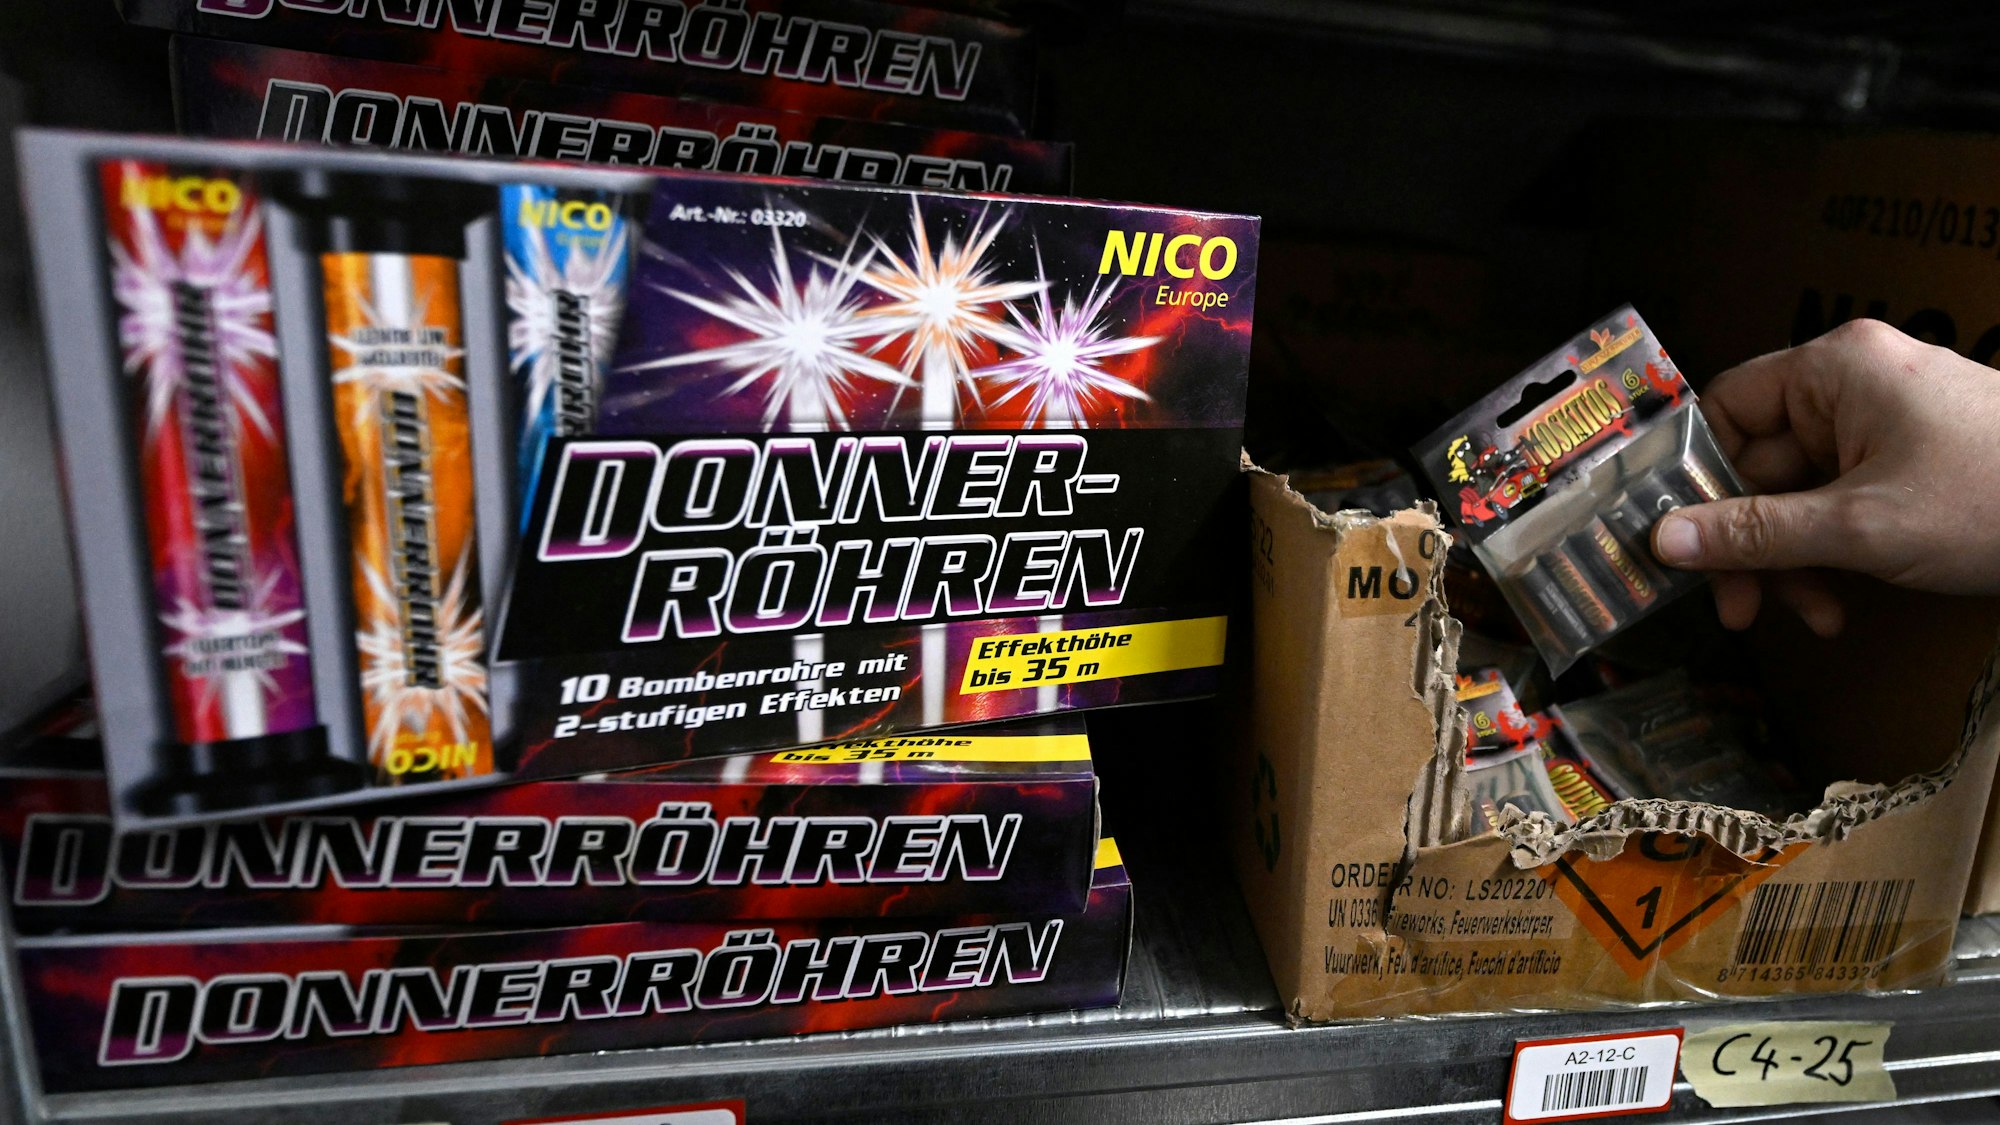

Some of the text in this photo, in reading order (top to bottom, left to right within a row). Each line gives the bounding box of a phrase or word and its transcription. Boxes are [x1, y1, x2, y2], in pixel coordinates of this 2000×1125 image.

[518, 200, 612, 231] NICO
[750, 207, 807, 227] 03320
[1097, 229, 1239, 281] NICO
[1155, 285, 1230, 312] Europe
[1622, 367, 1641, 389] 6
[538, 434, 1120, 562] DONNER-
[621, 526, 1145, 643] RÖHREN
[977, 631, 1133, 661] Effekthöhe
[560, 652, 909, 706] 10 Bombenrohre mit
[969, 656, 1101, 688] bis 35 m
[553, 685, 903, 740] 2-stufigen Effekten
[1473, 710, 1492, 730] 6
[385, 740, 478, 775] NICO
[782, 748, 936, 762] bis 35 m
[14, 801, 1023, 907] DONNERRÖHREN
[1418, 876, 1456, 900] NO:
[1465, 878, 1558, 901] LS202201
[1328, 899, 1346, 928] UN
[1450, 909, 1554, 941] Feuerwerkskörper,
[1635, 886, 1662, 929] 1
[1324, 945, 1383, 981] Vuurwerk,
[1410, 951, 1464, 981] d'artifice,
[1507, 949, 1562, 976] d'artificio
[1716, 967, 1729, 983] 8
[1736, 966, 1807, 983] 714365
[97, 918, 1064, 1067] DONNERRÖHREN
[1565, 1046, 1637, 1067] A2-12-C
[1711, 1032, 1874, 1087] C4-25
